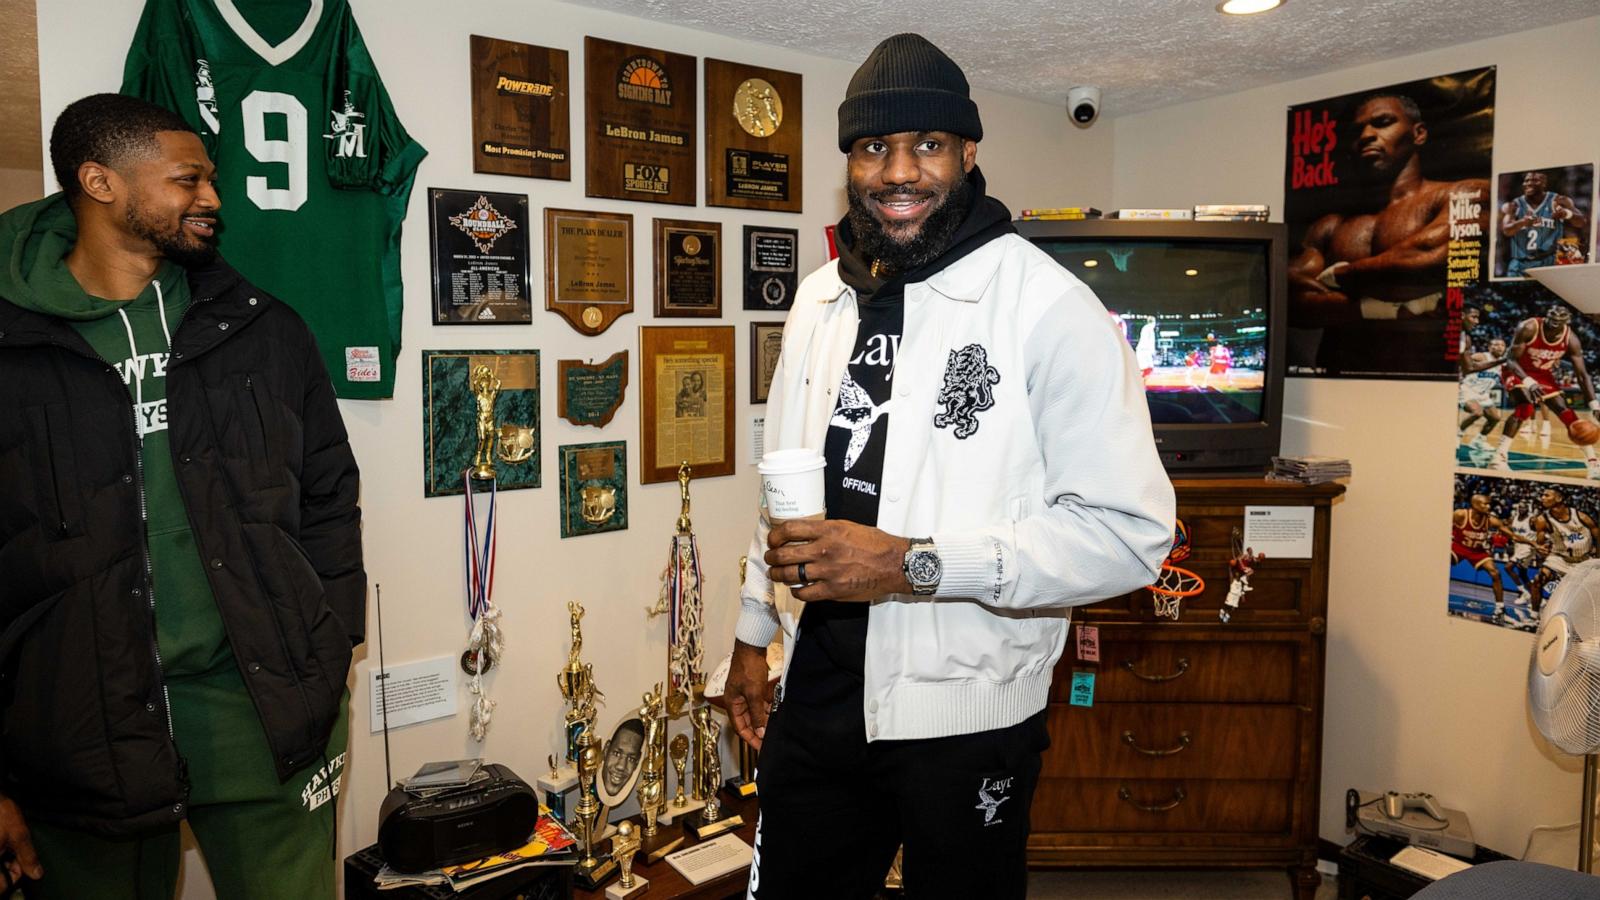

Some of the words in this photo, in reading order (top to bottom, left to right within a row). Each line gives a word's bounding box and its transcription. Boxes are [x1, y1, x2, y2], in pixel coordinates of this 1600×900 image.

[618, 83, 654, 103] SIGNING
[654, 89, 672, 105] DAY
[606, 124, 647, 140] LeBron
[649, 130, 684, 145] James
[1292, 110, 1337, 155] He's
[241, 90, 308, 212] 9
[484, 144, 502, 154] Most
[502, 146, 537, 159] Promising
[537, 150, 565, 161] Prospect
[633, 165, 663, 182] FOX
[752, 160, 787, 169] PLAYER
[1292, 150, 1338, 189] Back.
[625, 178, 654, 190] SPORTS
[654, 181, 669, 191] NET
[1448, 199, 1482, 221] Mike
[463, 218, 505, 229] ROUNDBALL
[560, 227, 576, 235] THE
[576, 228, 597, 236] PLAIN
[597, 229, 624, 238] DEALER
[1448, 220, 1482, 241] Tyson.
[1526, 230, 1538, 251] 2
[1447, 256, 1480, 269] Saturday,
[842, 477, 878, 496] OFFICIAL
[980, 776, 1014, 794] Layr
